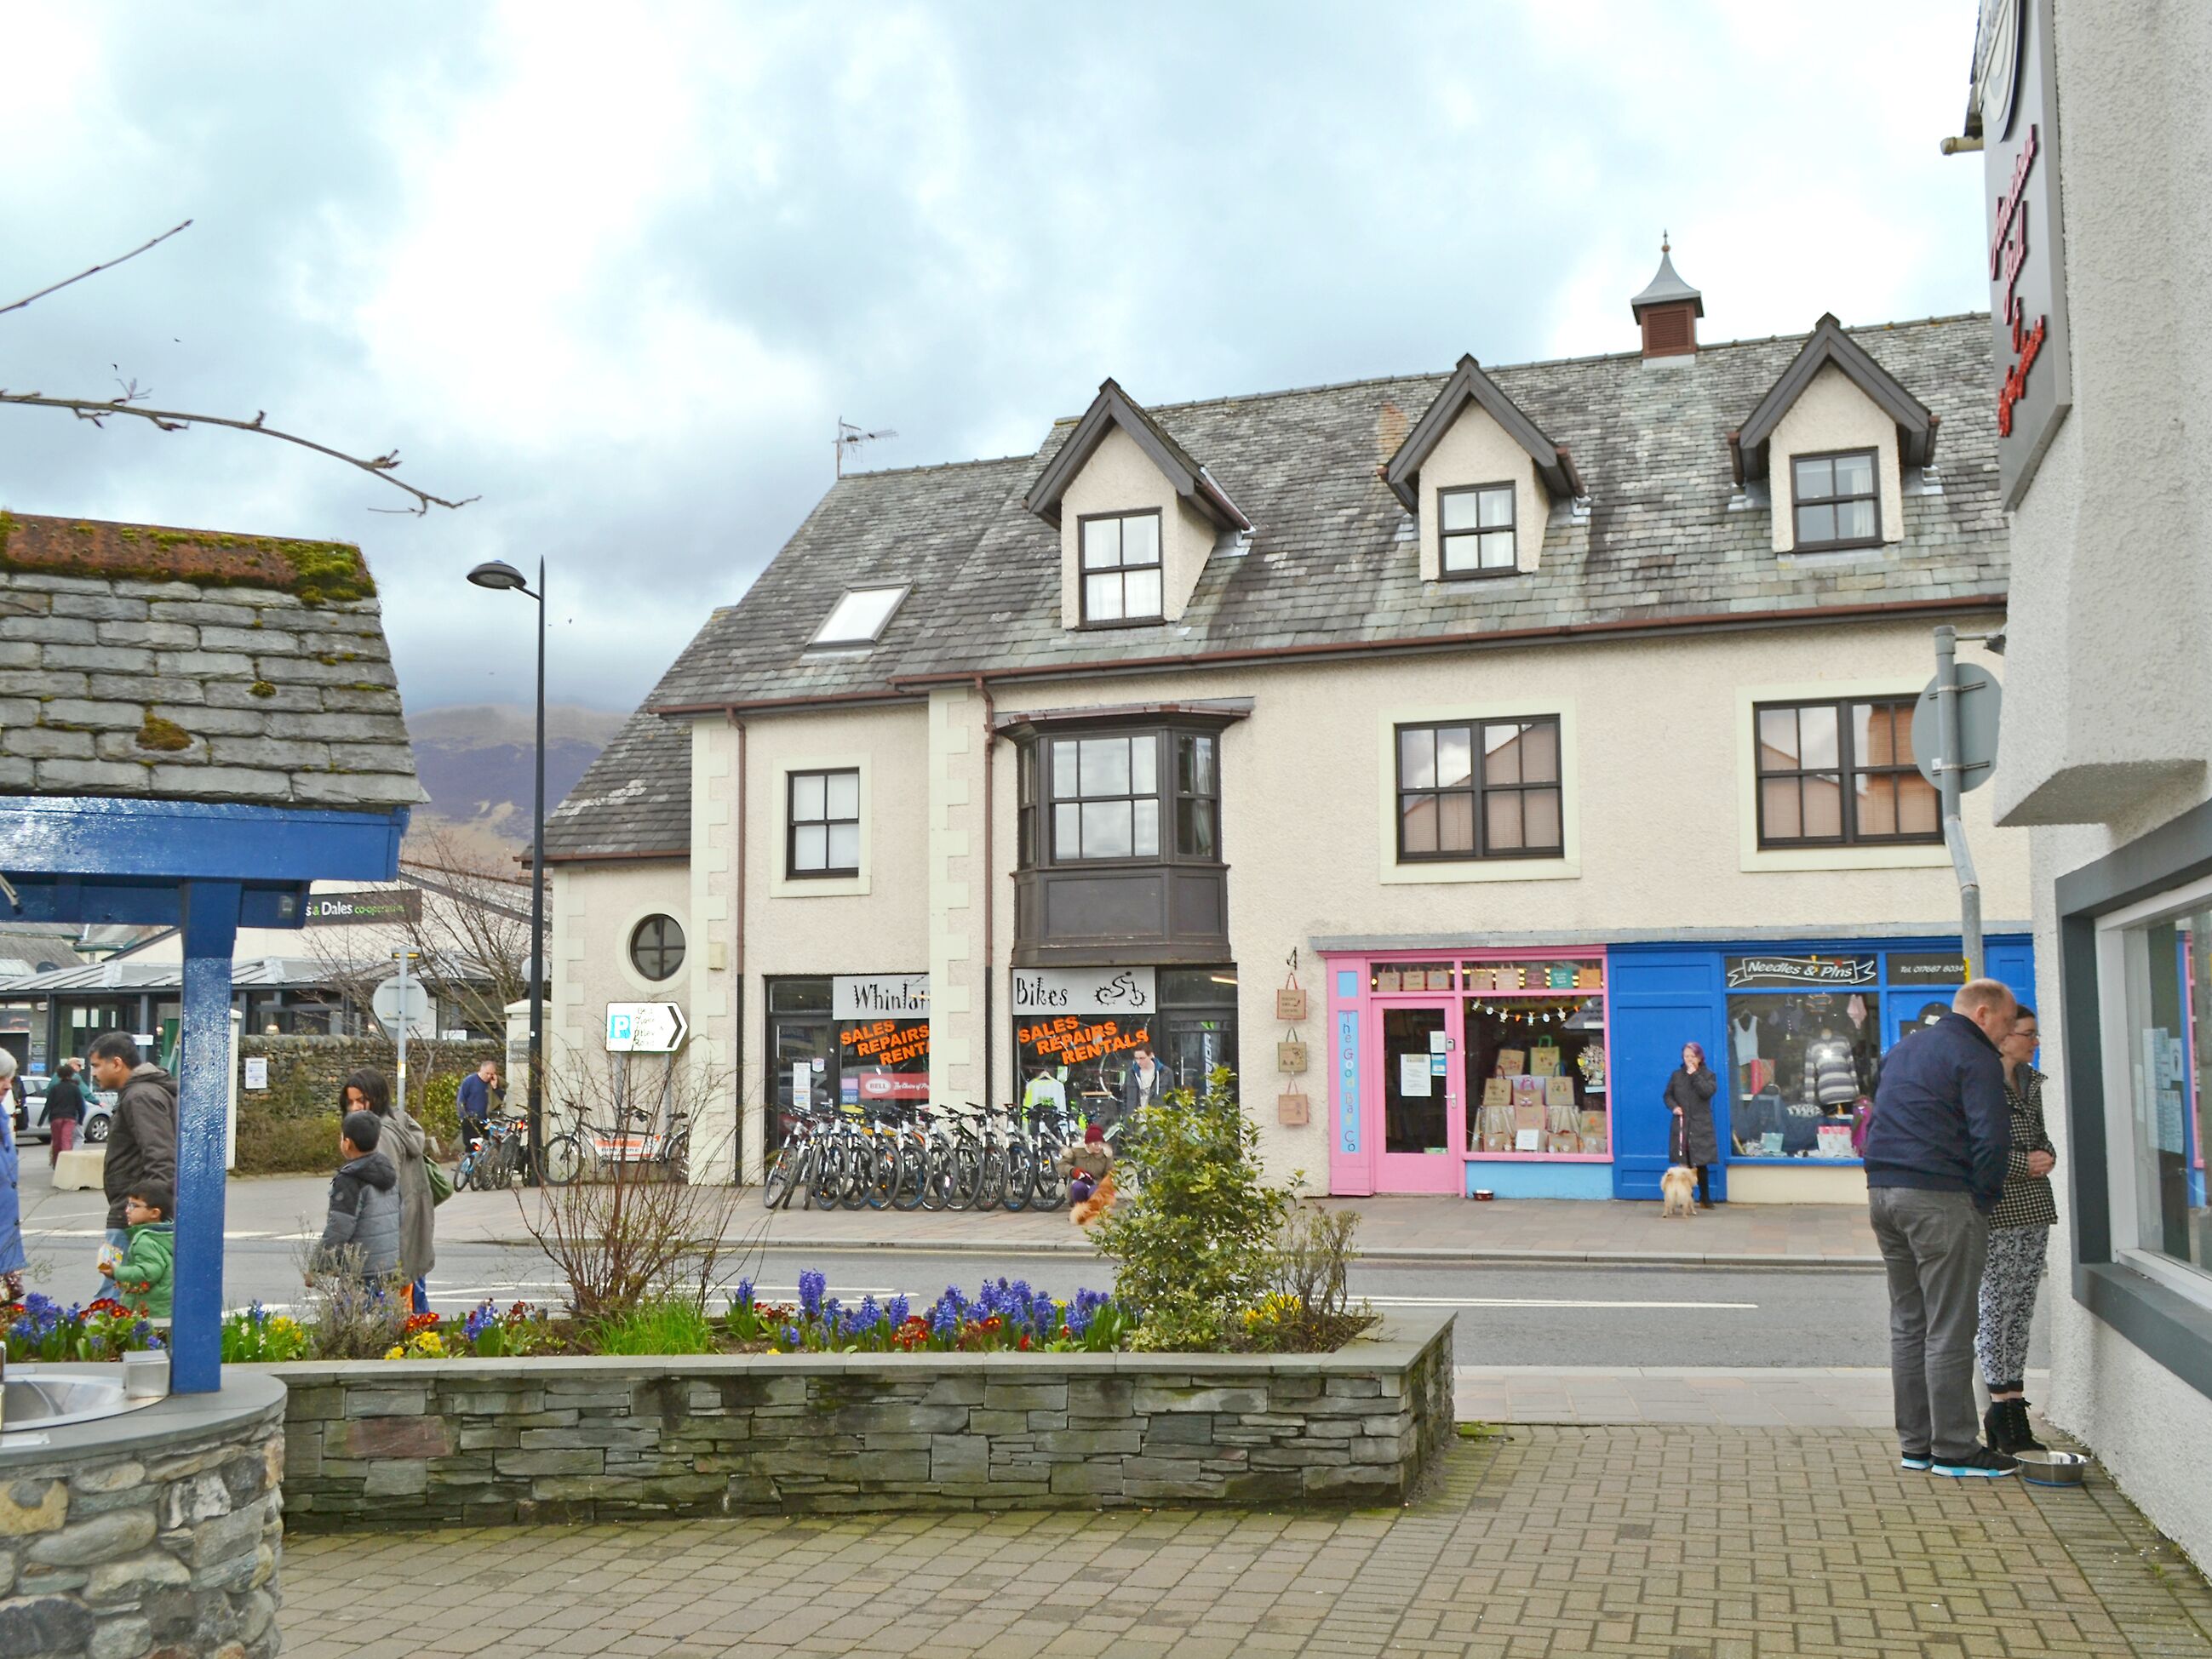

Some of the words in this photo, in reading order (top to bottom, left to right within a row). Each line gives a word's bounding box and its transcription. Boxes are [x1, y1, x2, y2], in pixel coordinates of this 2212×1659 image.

[312, 906, 320, 916] &
[321, 901, 352, 916] Dales
[1748, 961, 1801, 975] Needles
[1803, 965, 1815, 976] &
[1017, 976, 1069, 1007] Bikes
[614, 1015, 628, 1038] P
[840, 1019, 896, 1045] SALES
[857, 1025, 930, 1056] REPAIRS
[1018, 1016, 1080, 1044] SALES
[1036, 1021, 1118, 1055] REPAIRS
[1062, 1028, 1149, 1065] RENTALS
